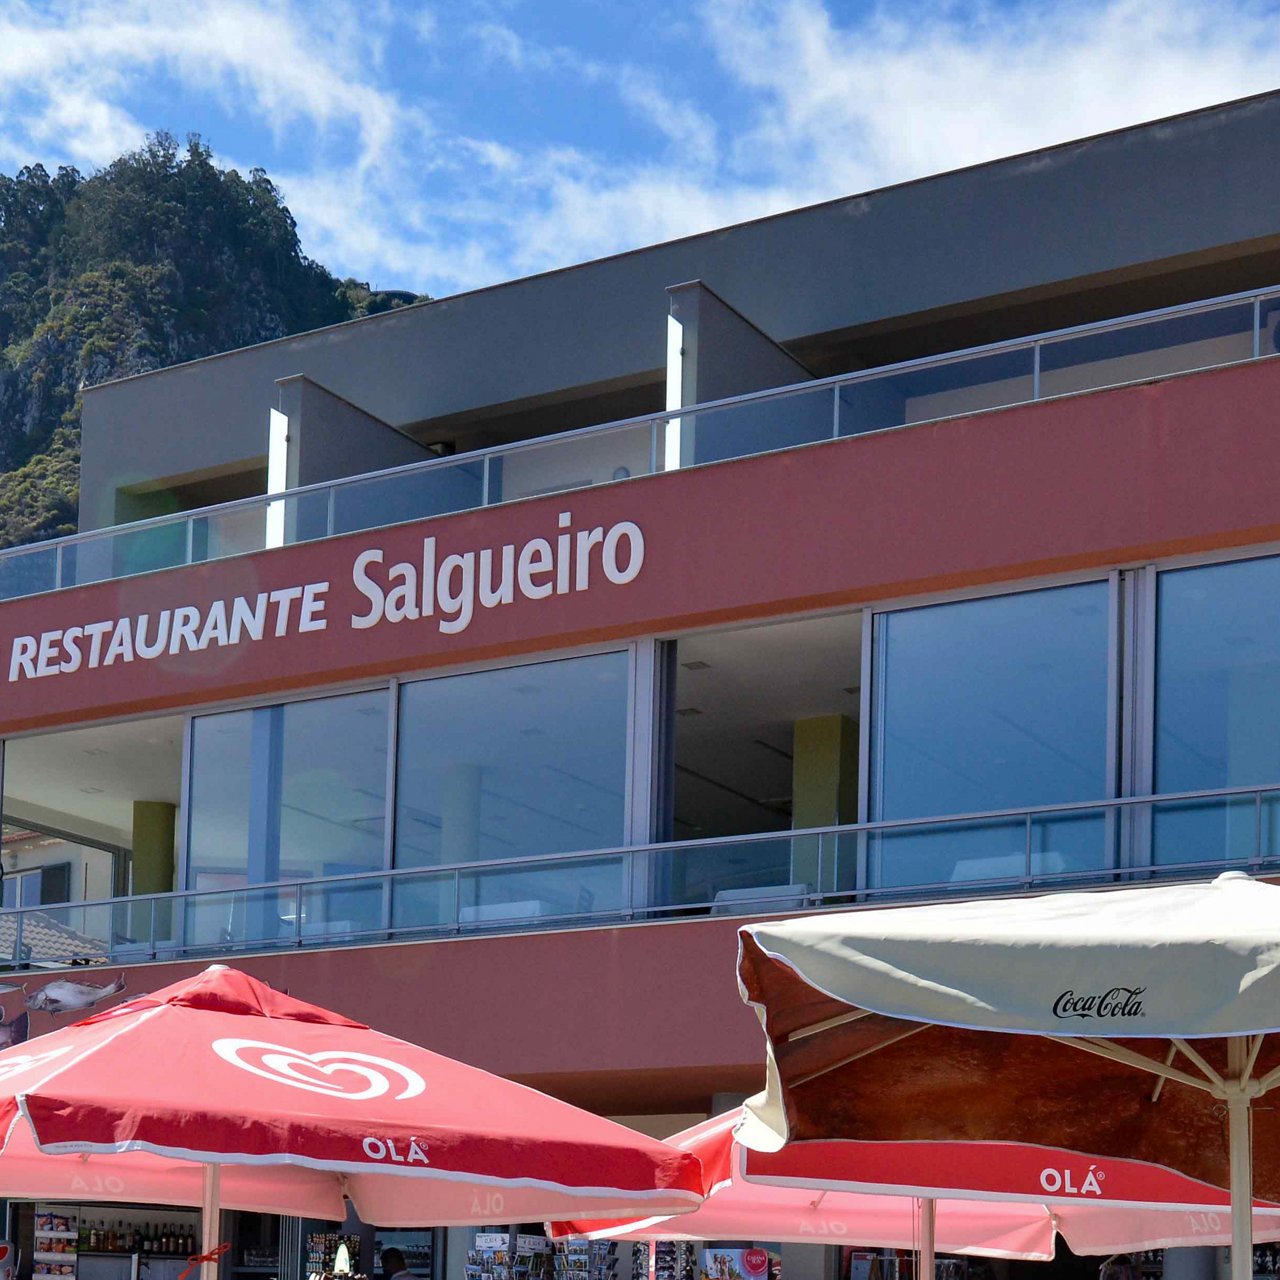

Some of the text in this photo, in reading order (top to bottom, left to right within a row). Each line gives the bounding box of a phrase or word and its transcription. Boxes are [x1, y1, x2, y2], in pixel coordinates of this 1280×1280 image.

[7, 581, 330, 683] RESTAURANTE
[350, 511, 646, 635] Salgueiro
[1052, 986, 1148, 1020] Coca-Cola
[362, 1136, 431, 1165] OLÁ
[1039, 1164, 1103, 1196] OLÁ
